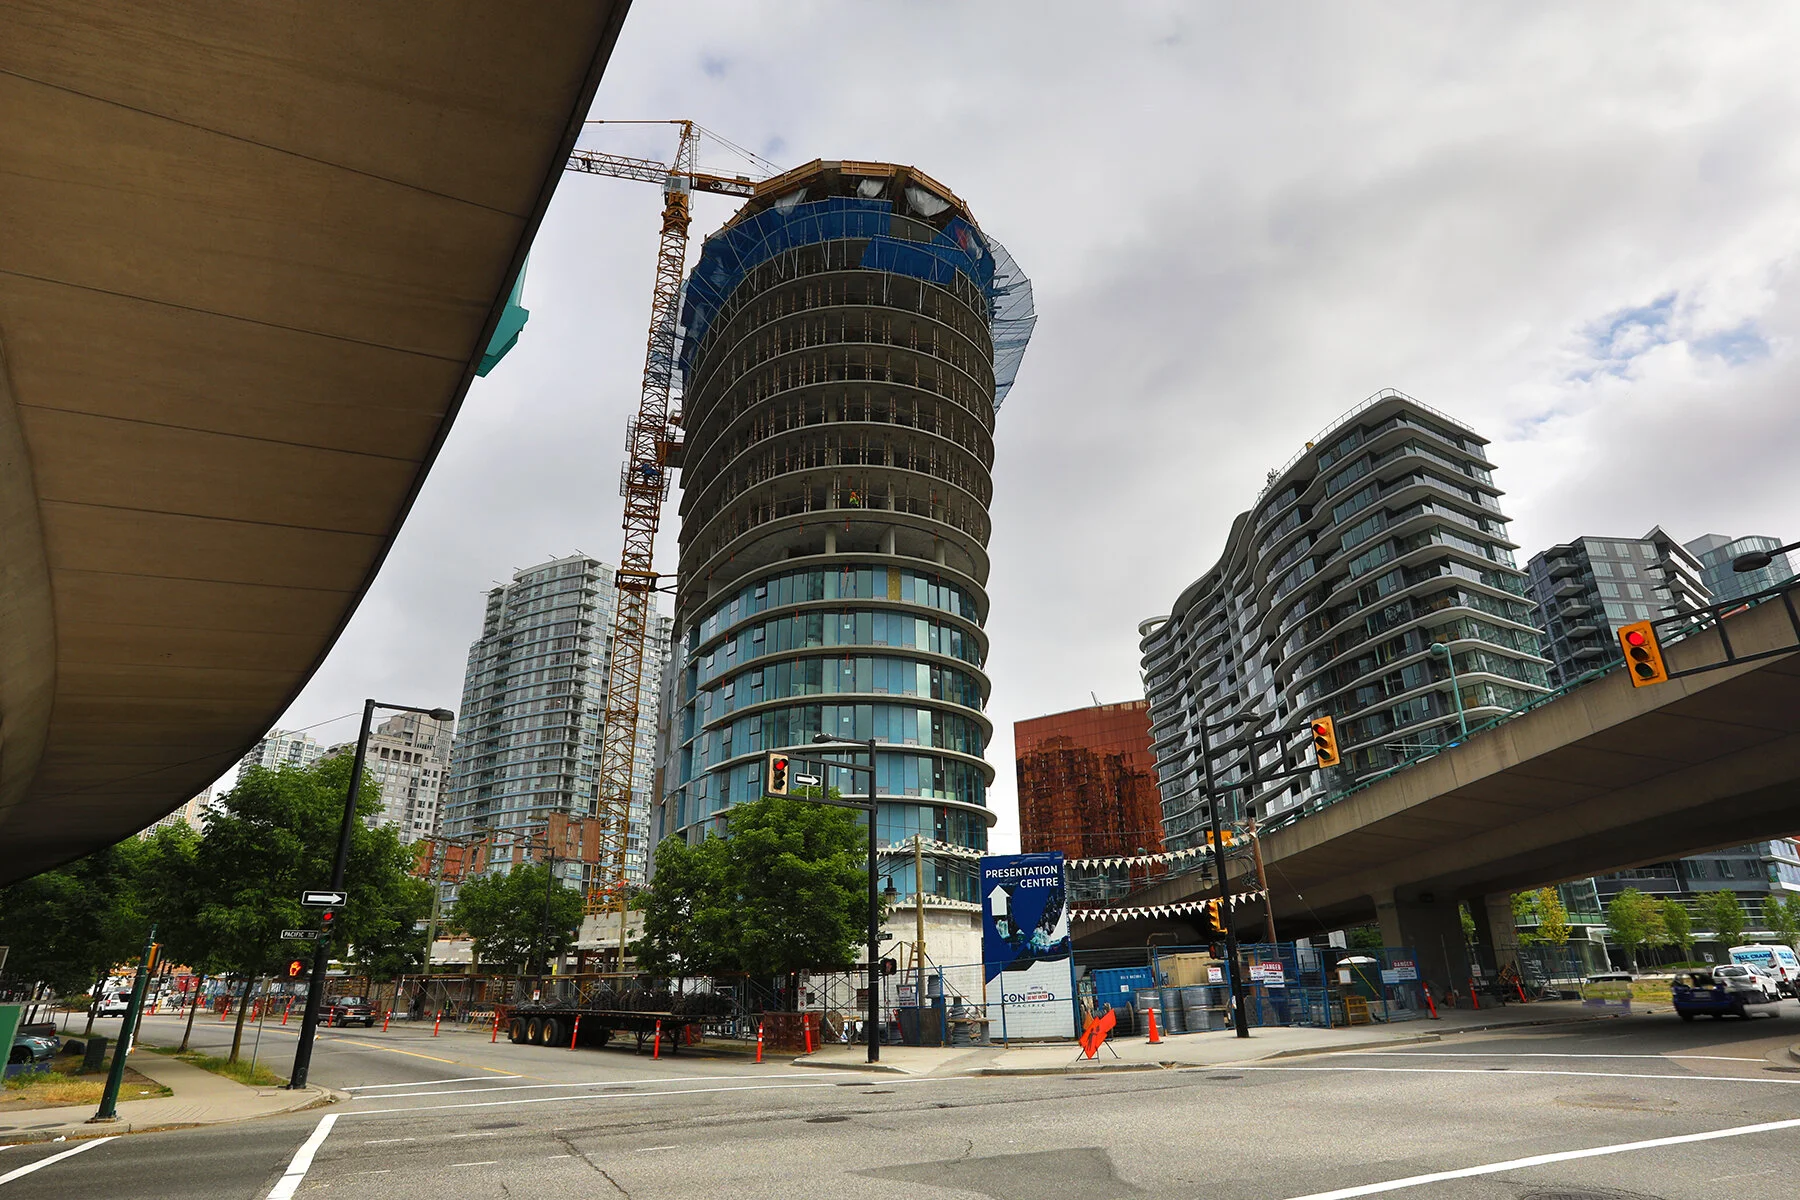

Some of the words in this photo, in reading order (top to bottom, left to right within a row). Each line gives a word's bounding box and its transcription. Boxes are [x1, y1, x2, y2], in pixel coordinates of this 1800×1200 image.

[985, 865, 1058, 879] PRESENTATION
[1020, 877, 1059, 889] CENTRE
[1003, 993, 1055, 1002] COND
